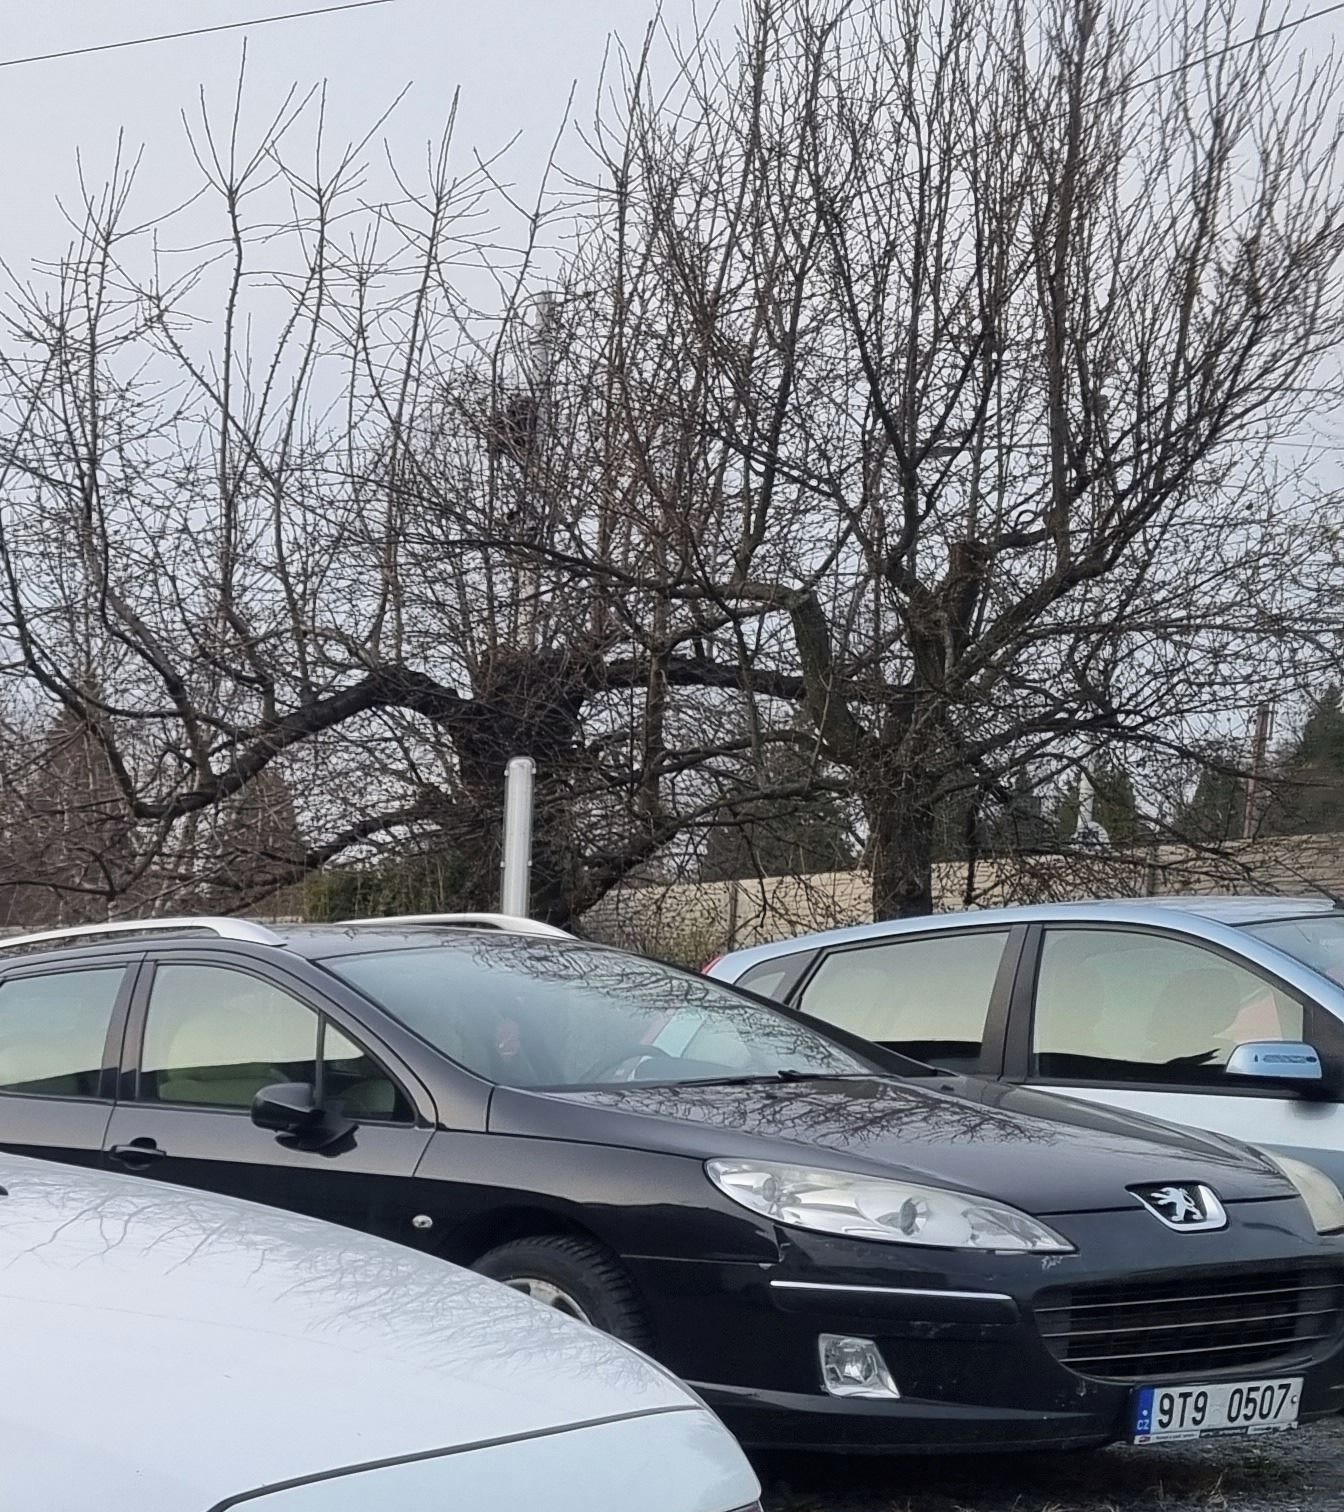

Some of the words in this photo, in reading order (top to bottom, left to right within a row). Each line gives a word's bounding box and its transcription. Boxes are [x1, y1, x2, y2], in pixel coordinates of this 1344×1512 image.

[1158, 1390, 1209, 1429] 9T9
[1227, 1383, 1292, 1423] 0507
[1136, 1419, 1150, 1431] CZ
